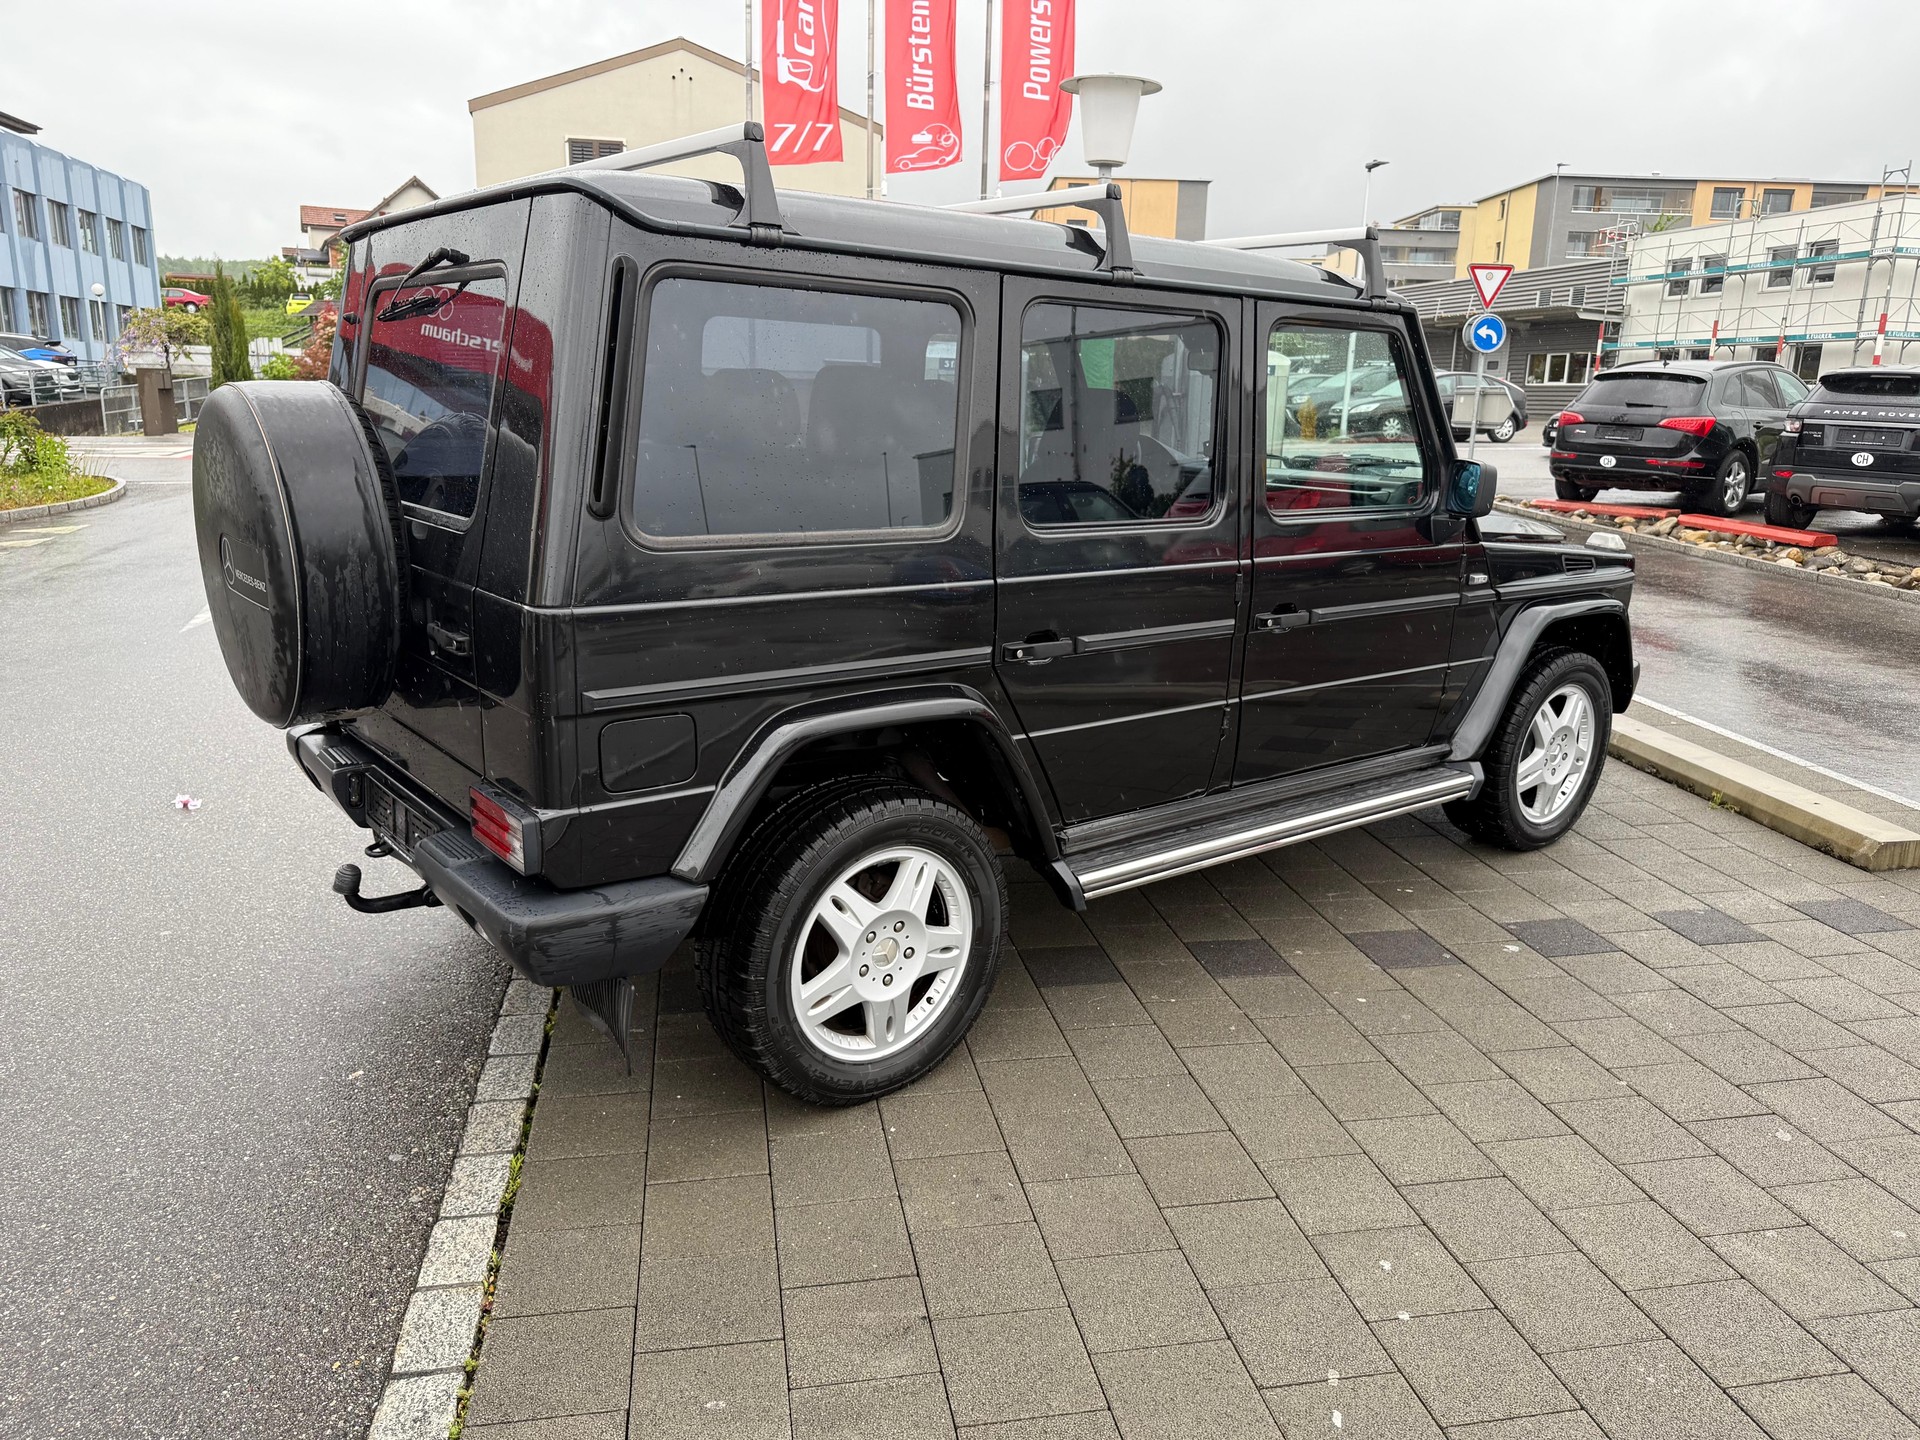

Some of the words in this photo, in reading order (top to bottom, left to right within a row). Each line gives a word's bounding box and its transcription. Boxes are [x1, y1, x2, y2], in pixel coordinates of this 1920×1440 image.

[906, 0, 935, 110] Bürsten
[770, 121, 833, 152] 7/7
[1856, 454, 1870, 464] CH
